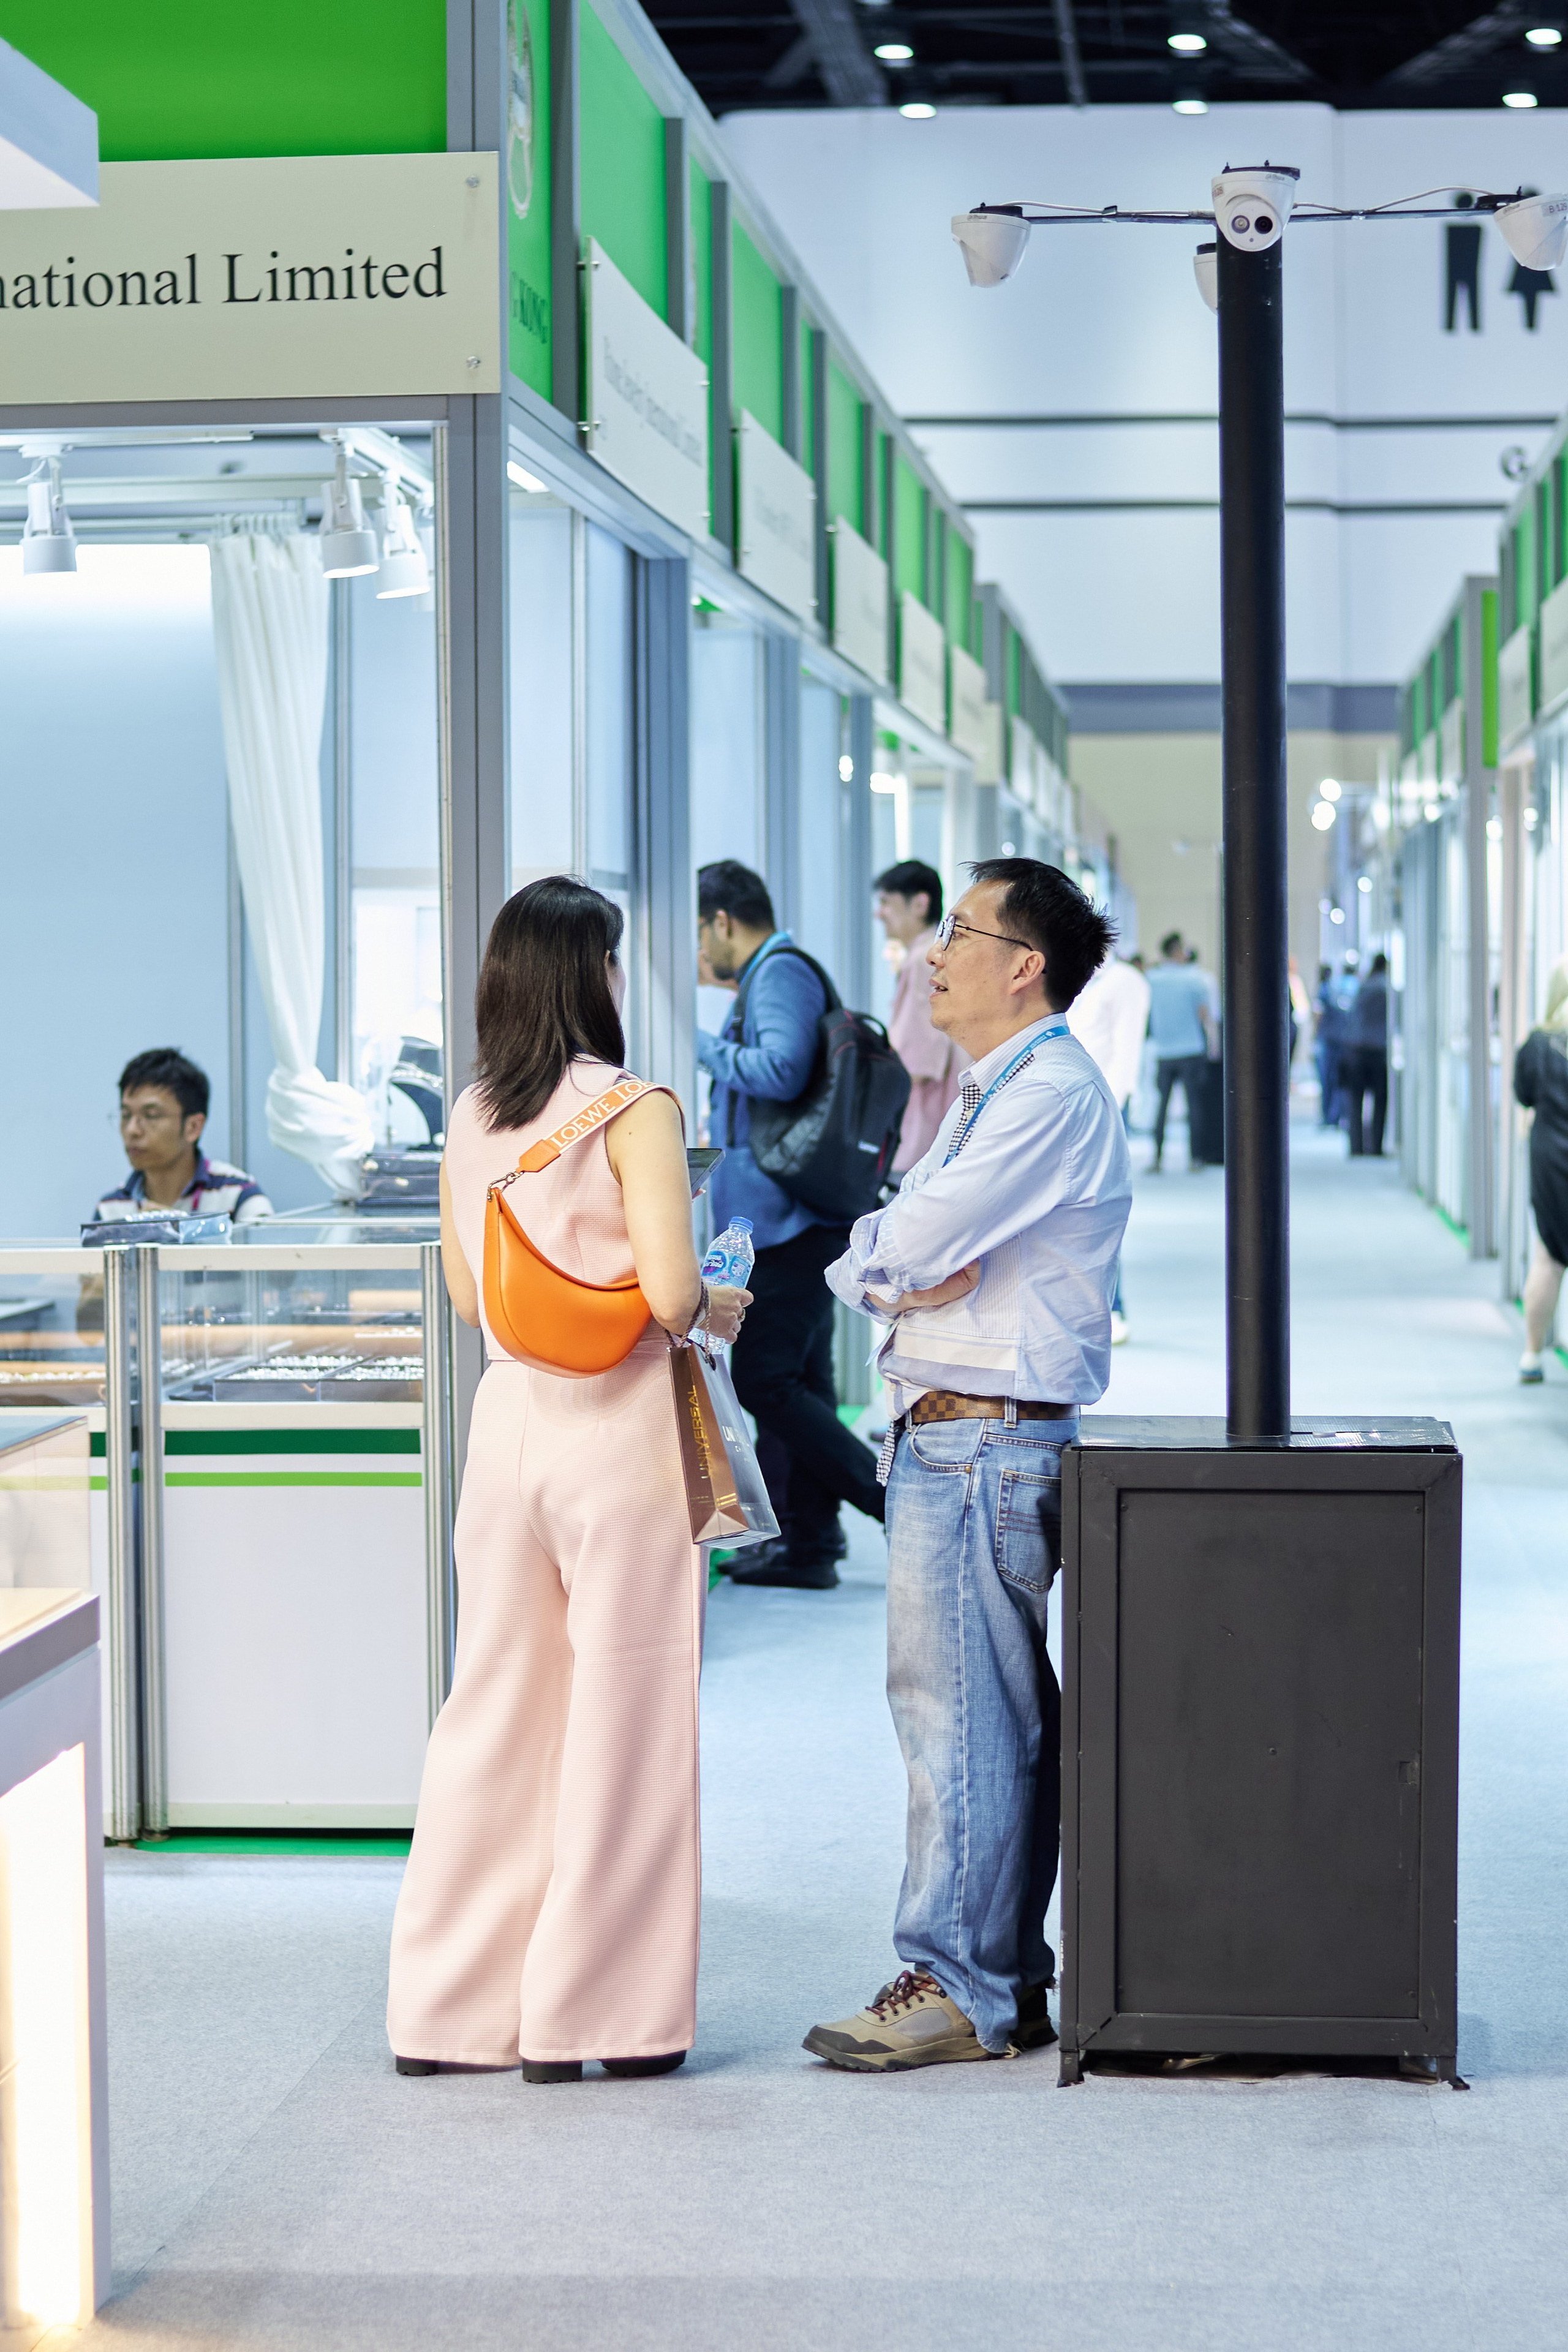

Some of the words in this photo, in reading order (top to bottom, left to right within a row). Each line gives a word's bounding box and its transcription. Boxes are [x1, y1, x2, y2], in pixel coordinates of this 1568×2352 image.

[0, 252, 202, 308] ational
[222, 246, 448, 304] Limited
[549, 1098, 616, 1148] LOEWE
[687, 1384, 712, 1479] UNIVERSAL
